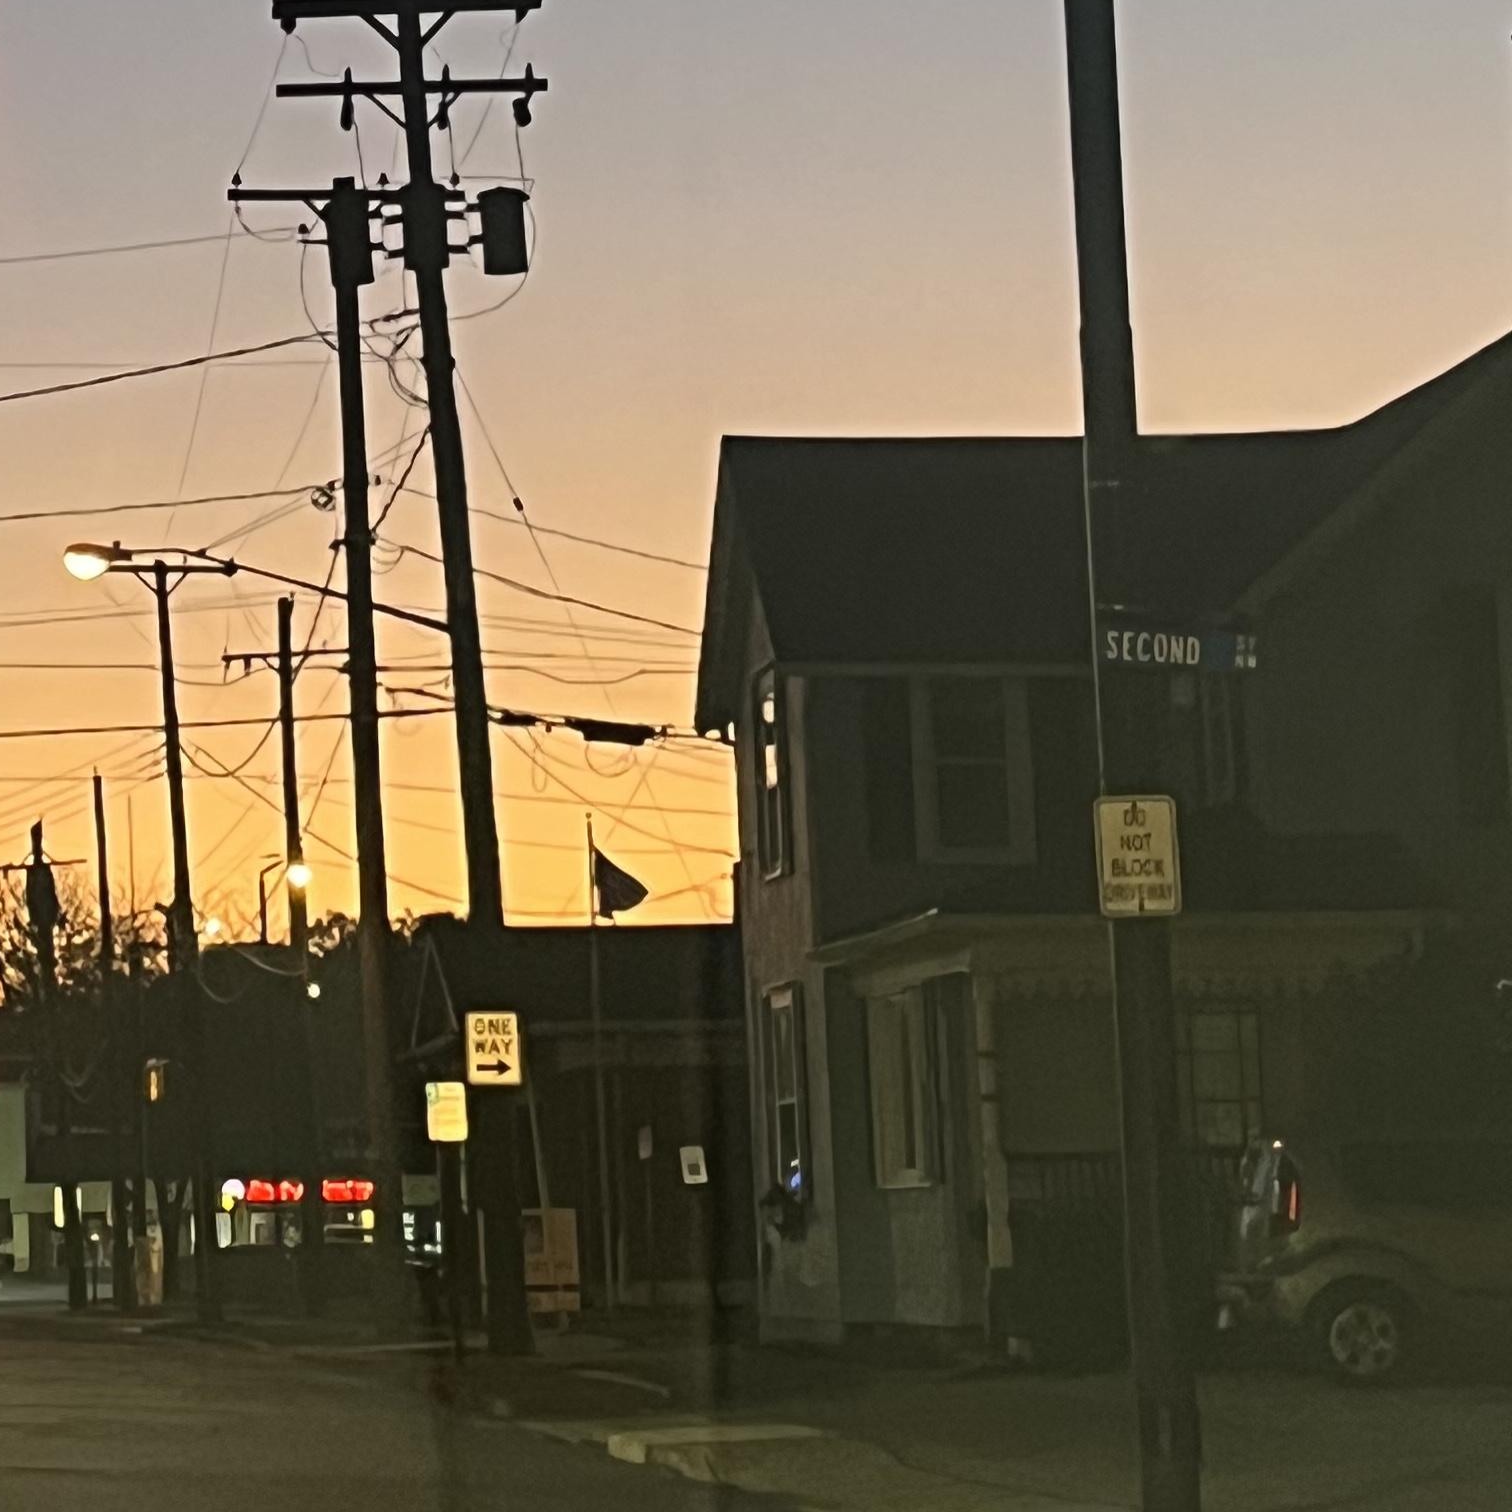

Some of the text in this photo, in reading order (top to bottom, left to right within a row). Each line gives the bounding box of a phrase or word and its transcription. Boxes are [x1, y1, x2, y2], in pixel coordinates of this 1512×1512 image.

[1106, 630, 1200, 665] SECOND
[1124, 809, 1146, 826] DO
[1120, 833, 1151, 851] NOT
[1112, 858, 1164, 877] BLOCK
[474, 1019, 511, 1035] ONE
[474, 1038, 512, 1054] WAY
